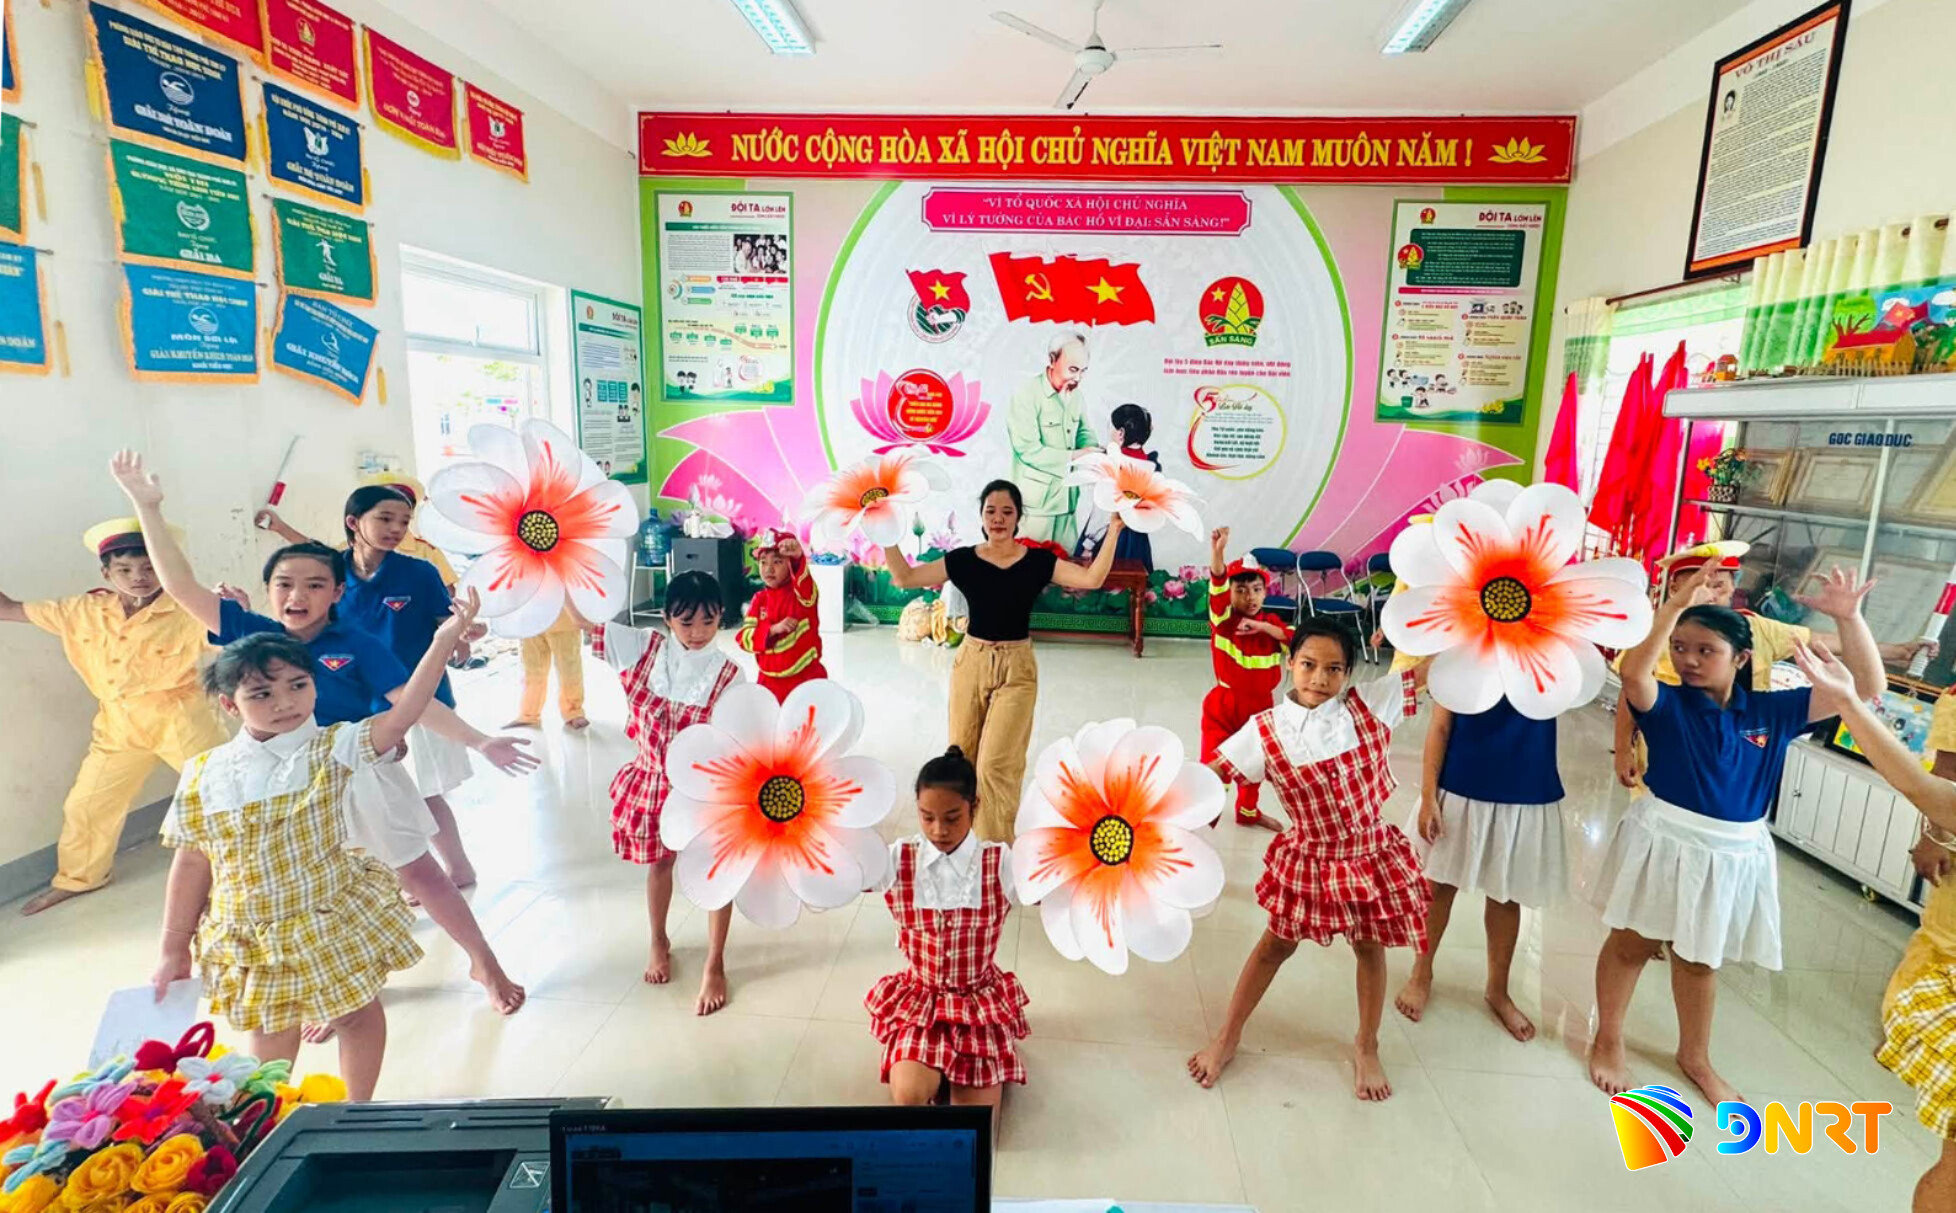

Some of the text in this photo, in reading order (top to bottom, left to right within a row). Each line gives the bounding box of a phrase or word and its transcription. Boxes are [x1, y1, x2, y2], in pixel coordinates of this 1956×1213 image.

[1757, 50, 1782, 70] THỊ
[731, 126, 1473, 172] NƯỚC CỘNG HÒA XÃ HỘI CHỦ NGHĨA VIỆT NAM MUÔN NĂM !
[731, 200, 747, 213] ĐỘI
[749, 203, 760, 212] TA
[1005, 193, 1022, 208] TỔ
[1025, 194, 1062, 210] QUỐC
[1065, 196, 1082, 209] XÃ
[1086, 196, 1109, 211] HỘI
[1113, 196, 1141, 210] CHỦ
[1145, 197, 1188, 210] NGHĨA
[942, 212, 956, 224] VÌ
[959, 211, 974, 225] LÝ
[978, 212, 1023, 226] TƯỞNG
[1026, 212, 1053, 226] CỦA
[1056, 213, 1083, 226] BÁC
[1086, 212, 1105, 226] HỒ
[1154, 212, 1180, 227] SẴN
[1479, 208, 1498, 223] ĐỘI
[1499, 212, 1512, 222] TA
